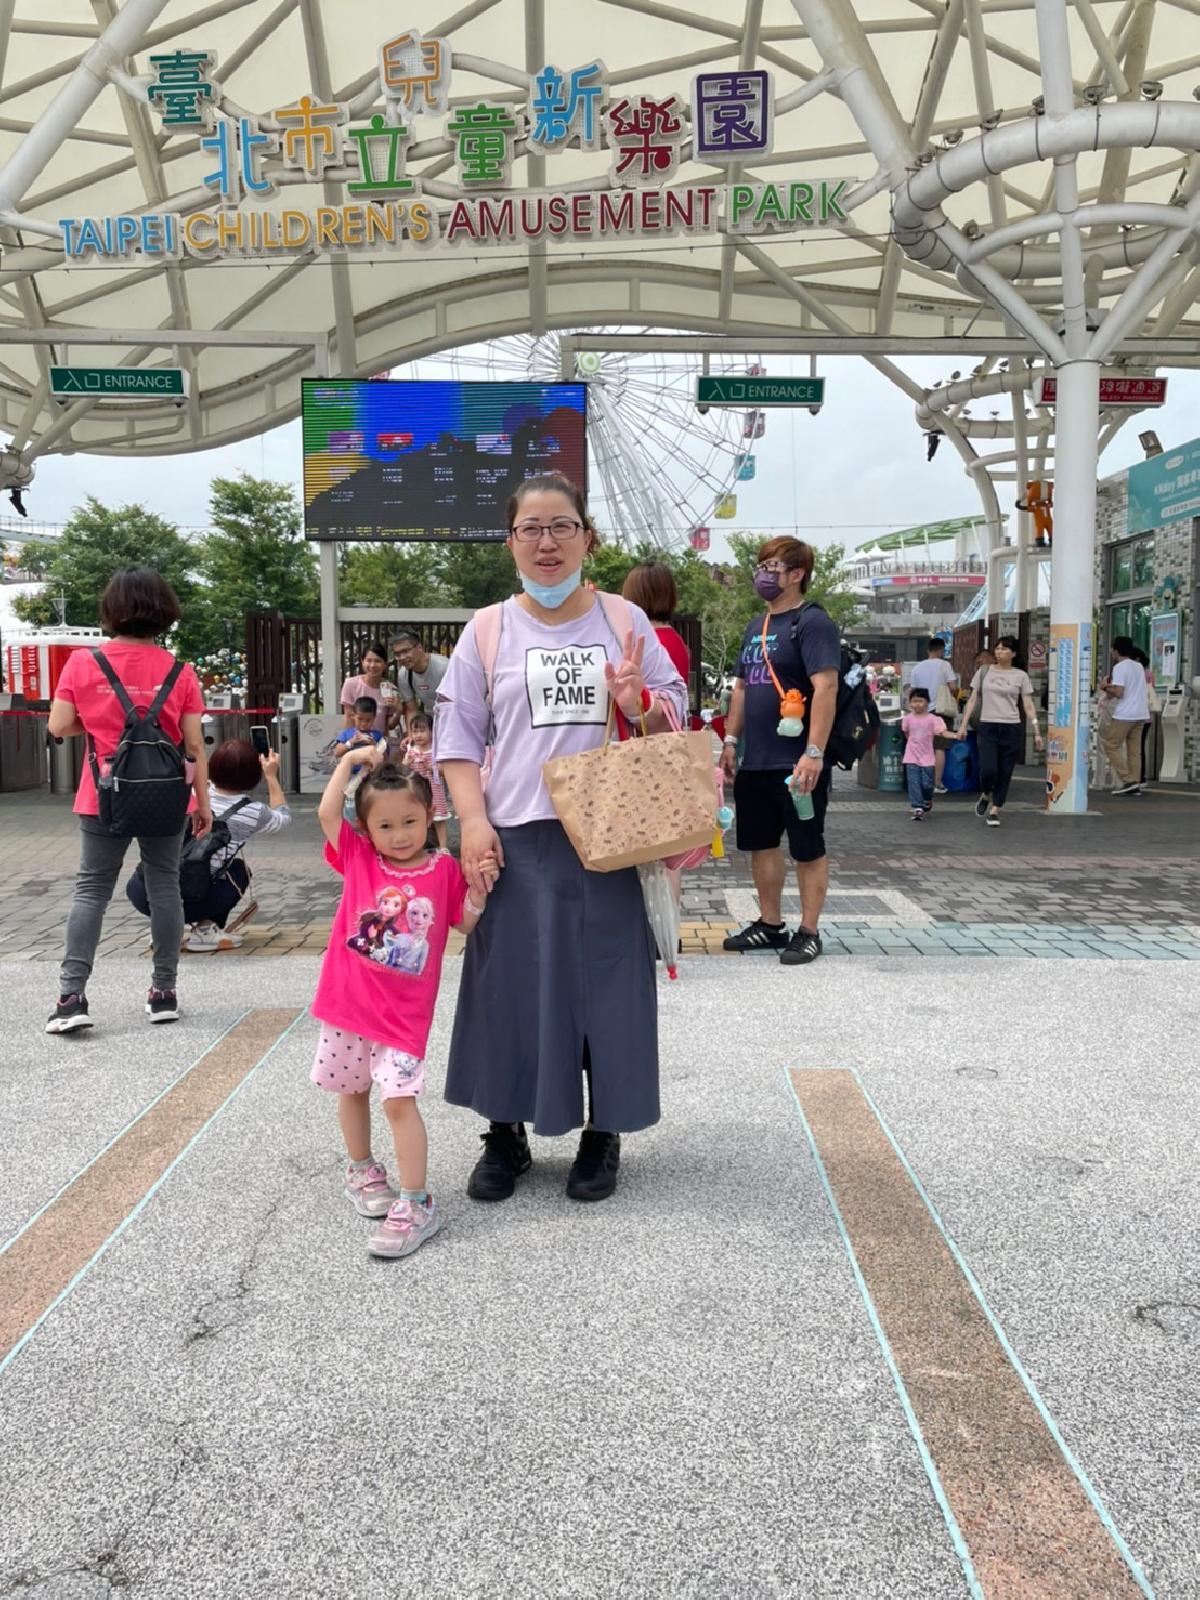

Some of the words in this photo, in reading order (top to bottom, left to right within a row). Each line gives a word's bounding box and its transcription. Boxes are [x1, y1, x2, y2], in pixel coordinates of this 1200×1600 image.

[147, 34, 768, 194] 臺北市立兒童新樂園
[59, 215, 174, 256] TAIPEI
[185, 205, 431, 250] CHILDREN'S
[447, 188, 716, 240] AMUSEMENT
[732, 180, 847, 225] PARK
[63, 370, 100, 390] 入口
[104, 374, 173, 389] ENTRANCE
[708, 381, 746, 400] 入口
[748, 385, 815, 399] ENTRANCE
[540, 651, 595, 667] WALK
[555, 667, 582, 685] OF
[543, 686, 596, 707] FAME
